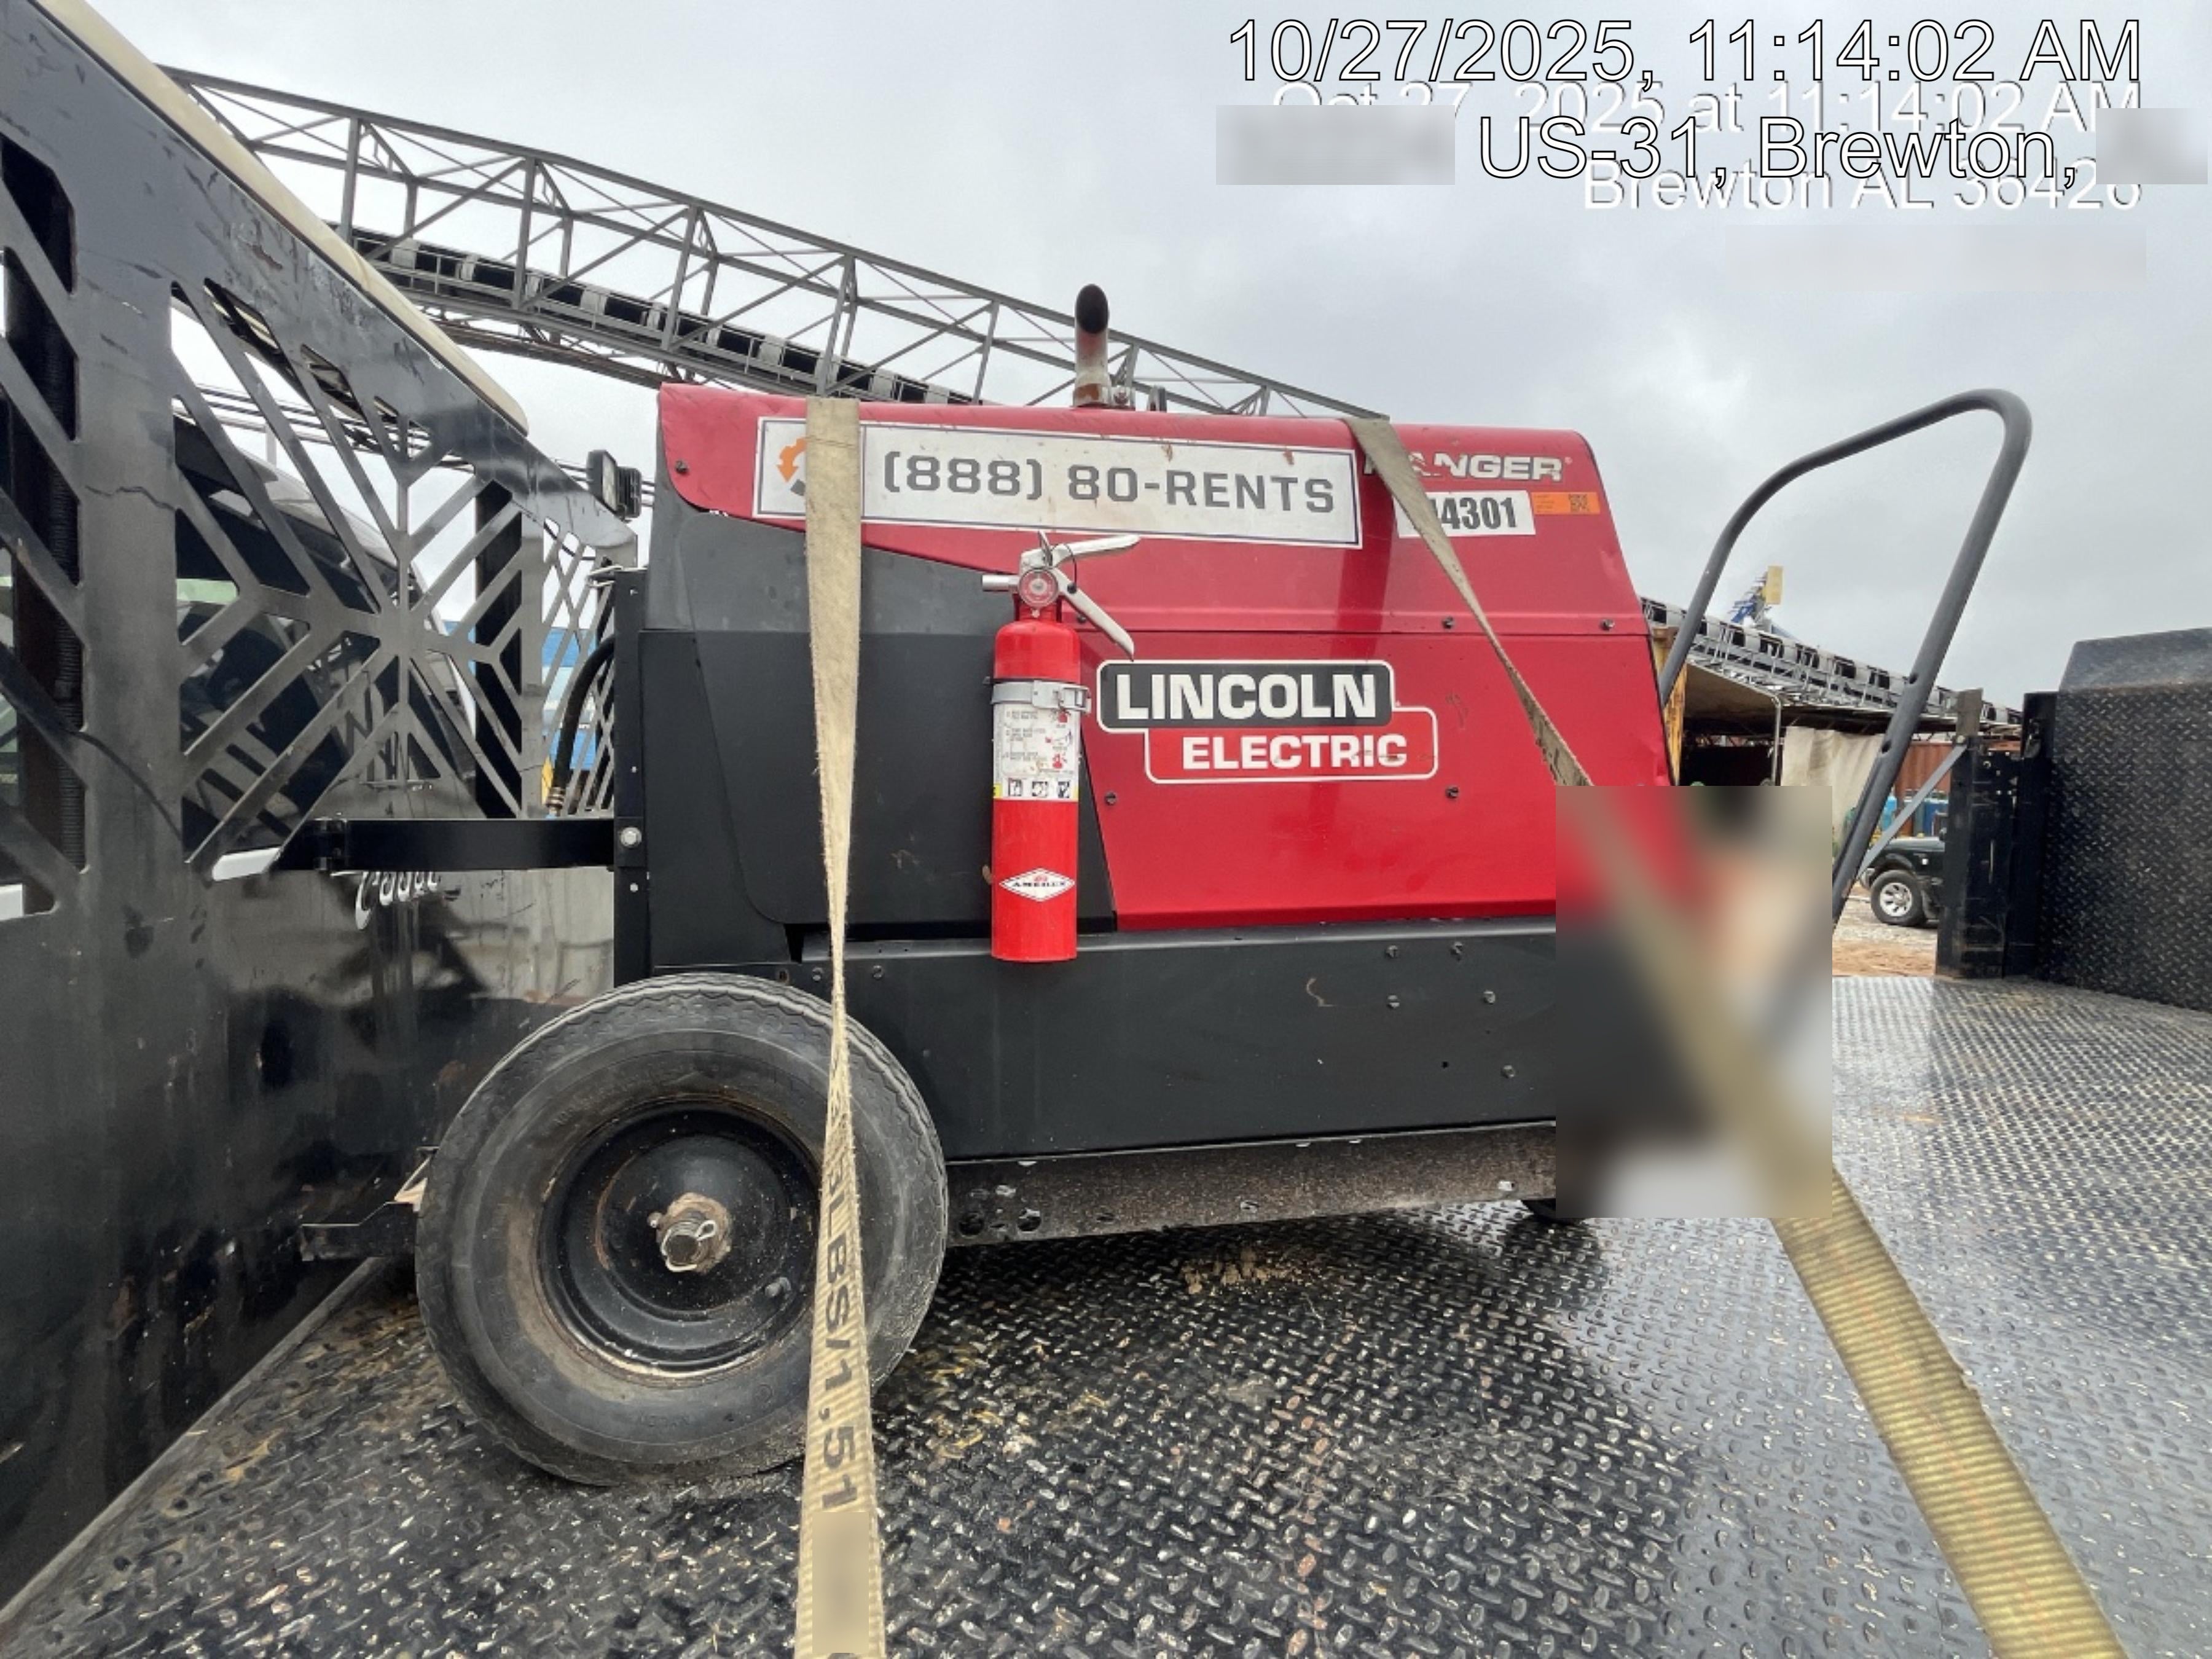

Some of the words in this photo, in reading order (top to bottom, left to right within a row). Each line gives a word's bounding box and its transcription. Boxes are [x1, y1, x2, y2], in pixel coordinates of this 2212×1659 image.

[883, 450, 1043, 501] (888)
[1067, 464, 1335, 514] 80-RENTS
[1432, 496, 1517, 530] 4301
[1116, 673, 1377, 721] LINCOLN
[1182, 733, 1408, 771] ELECTRIC
